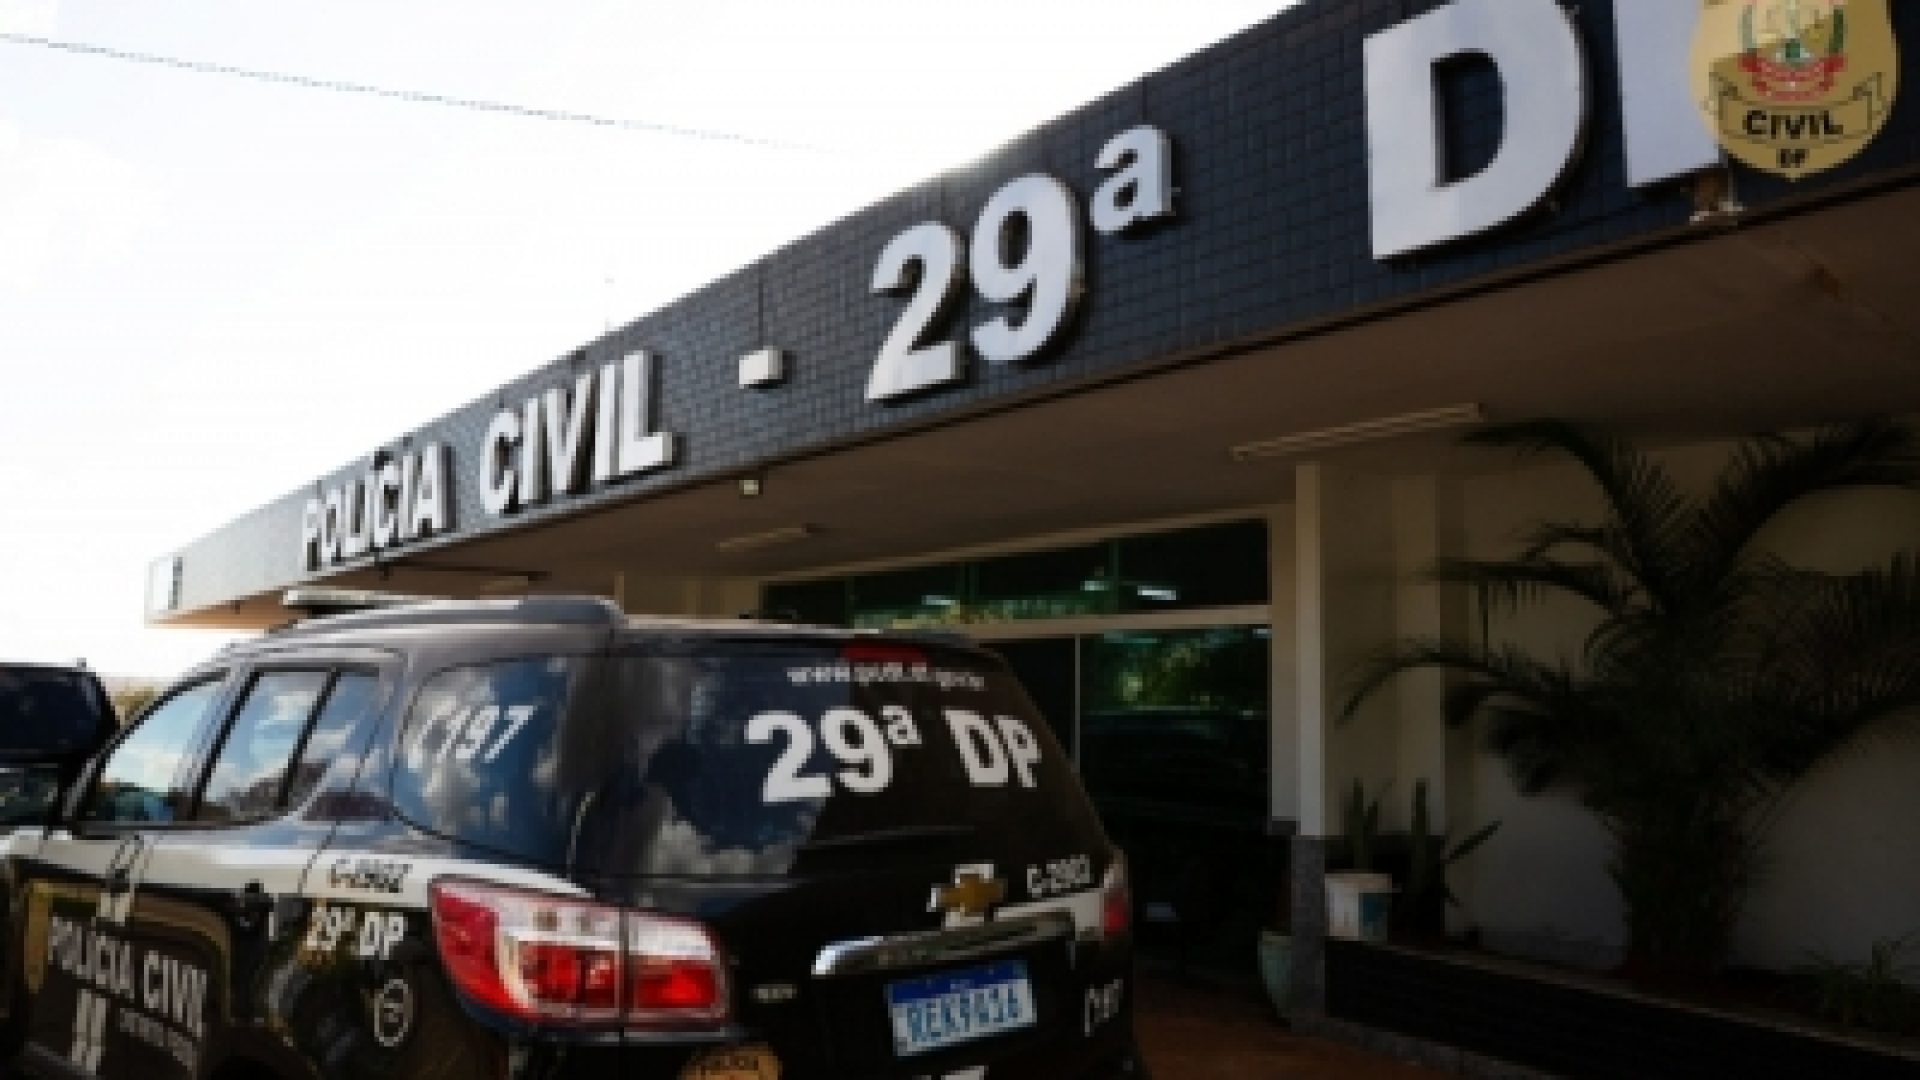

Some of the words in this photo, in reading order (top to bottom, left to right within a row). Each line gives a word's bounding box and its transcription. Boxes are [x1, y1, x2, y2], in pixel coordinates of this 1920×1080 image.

[1742, 109, 1844, 141] CIVIL
[479, 350, 674, 514] CIVIL
[943, 709, 1043, 788] DP
[358, 909, 406, 961] DP
